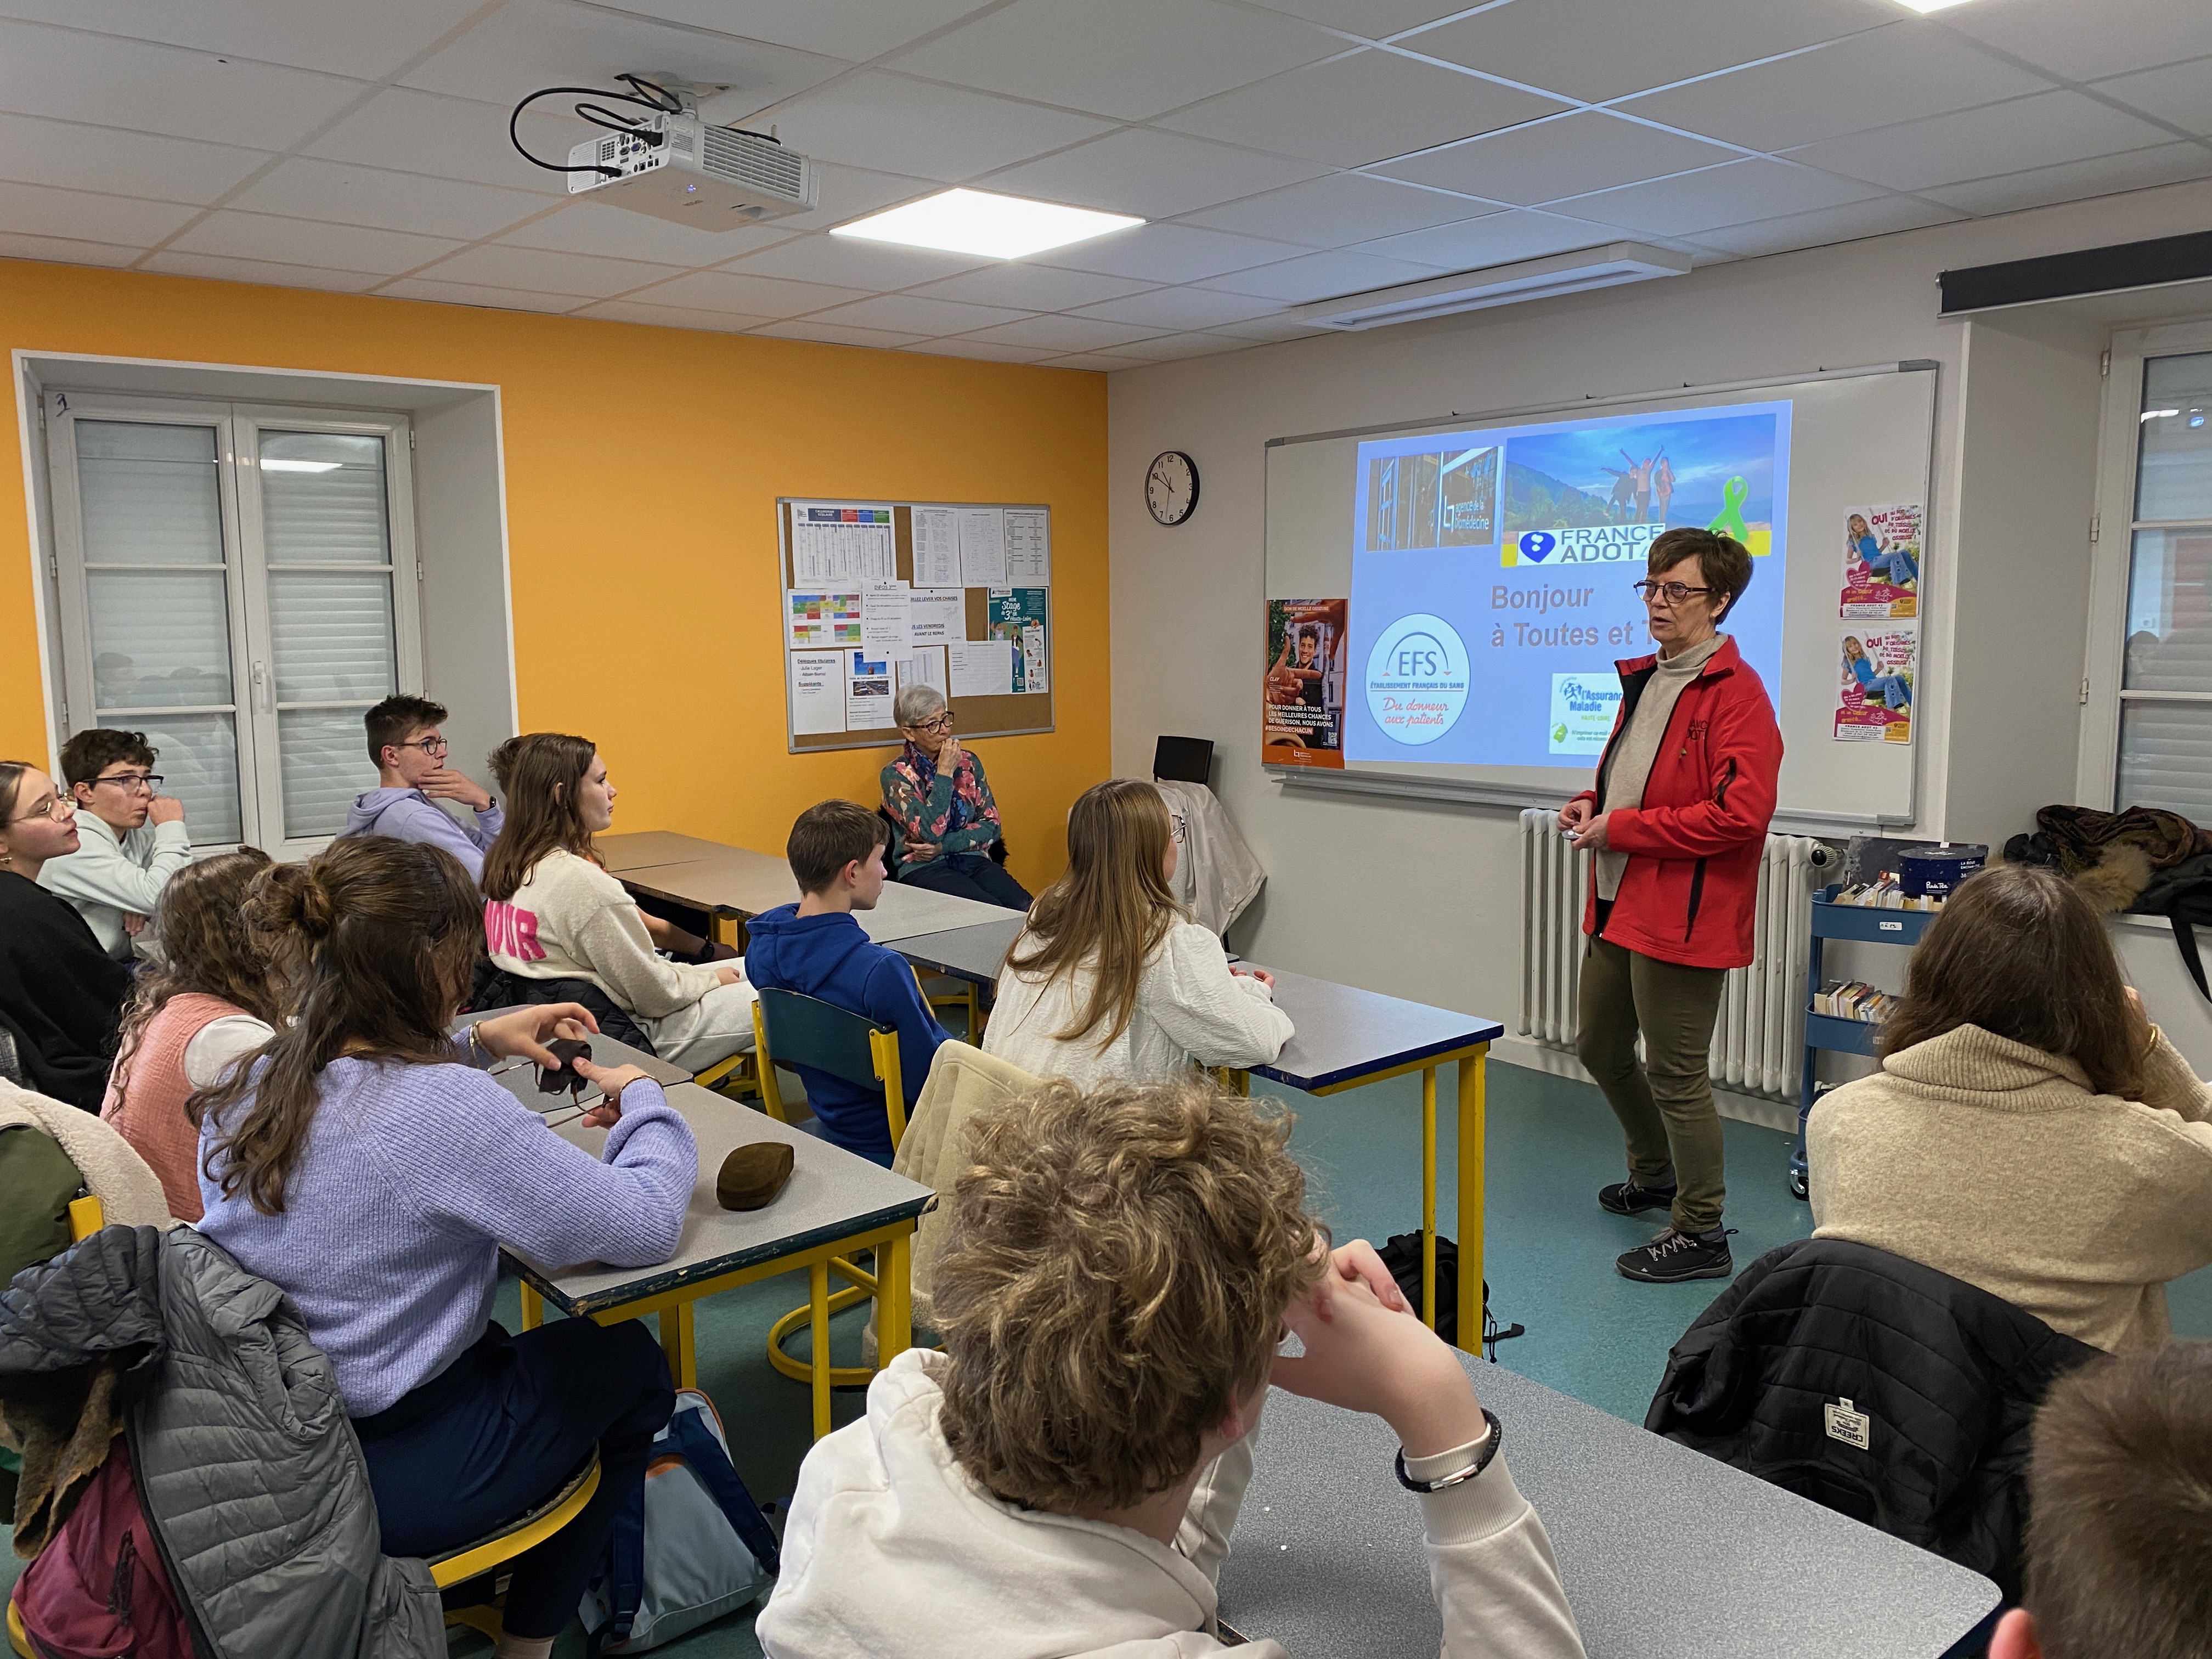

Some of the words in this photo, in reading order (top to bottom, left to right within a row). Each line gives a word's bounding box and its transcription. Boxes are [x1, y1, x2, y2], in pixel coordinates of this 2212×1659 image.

[1455, 501, 1473, 514] agence
[1473, 500, 1479, 511] de
[1480, 499, 1485, 510] la
[1455, 514, 1489, 530] biomédecine
[1871, 512, 1887, 525] OUI
[1561, 525, 1664, 544] FRANCE
[1002, 601, 1020, 611] Stage
[1491, 583, 1594, 614] Bonjour
[1491, 623, 1504, 647] à
[1514, 622, 1599, 646] Toutes
[1609, 620, 1633, 646] et
[1866, 637, 1882, 648] OUI
[1399, 651, 1436, 676] EFS
[1383, 697, 1403, 711] Du
[1406, 698, 1449, 711] donneur
[1570, 701, 1601, 711] Maladie
[1385, 715, 1404, 724] aux
[1406, 712, 1443, 728] patients
[1265, 725, 1312, 734] #BESOINDECHACUN
[1832, 1426, 1863, 1442] CREEKS
